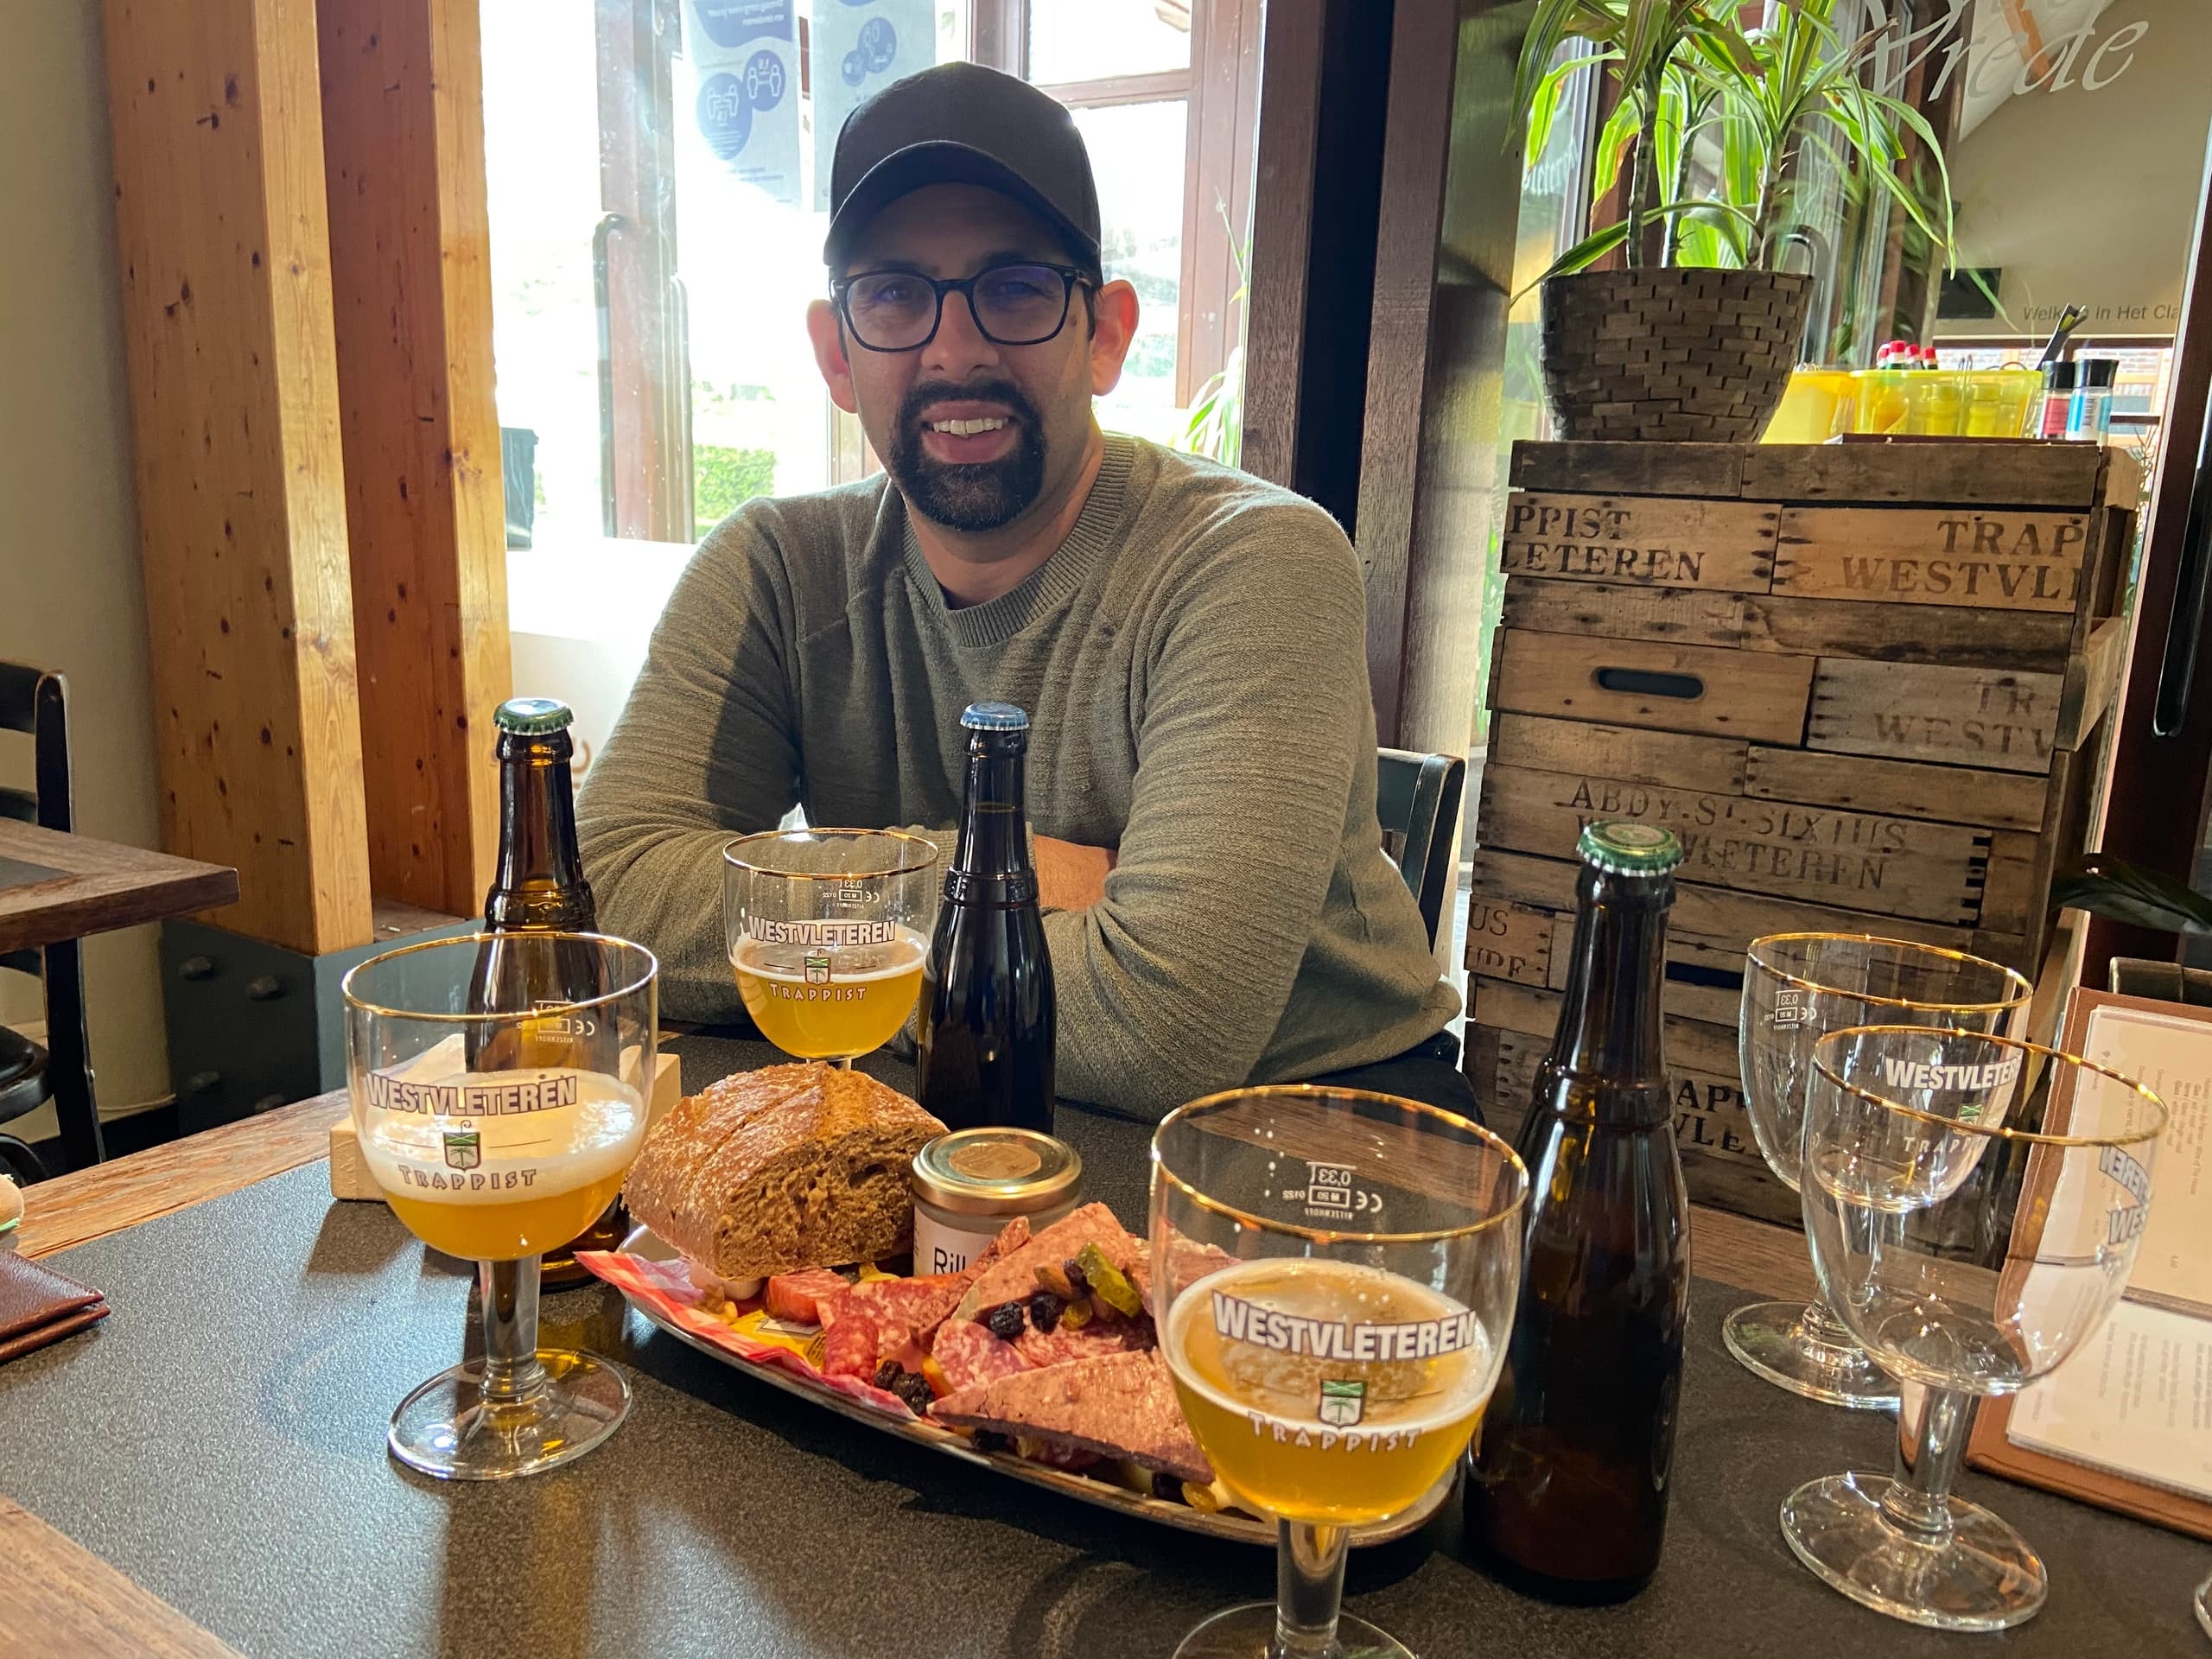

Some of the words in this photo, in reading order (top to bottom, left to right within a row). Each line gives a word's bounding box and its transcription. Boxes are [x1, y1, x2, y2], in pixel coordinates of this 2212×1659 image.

[2117, 305, 2147, 321] Het
[1936, 519, 2083, 558] TRAP
[748, 916, 896, 947] WESTVLETEREN
[769, 982, 867, 1002] TRAPPIST
[366, 1075, 578, 1116] WESTVLETEREN
[398, 1164, 537, 1191] TRAPPIST
[1211, 1289, 1477, 1363] WESTVLETEREN
[1247, 1409, 1427, 1453] TRAPPIST
